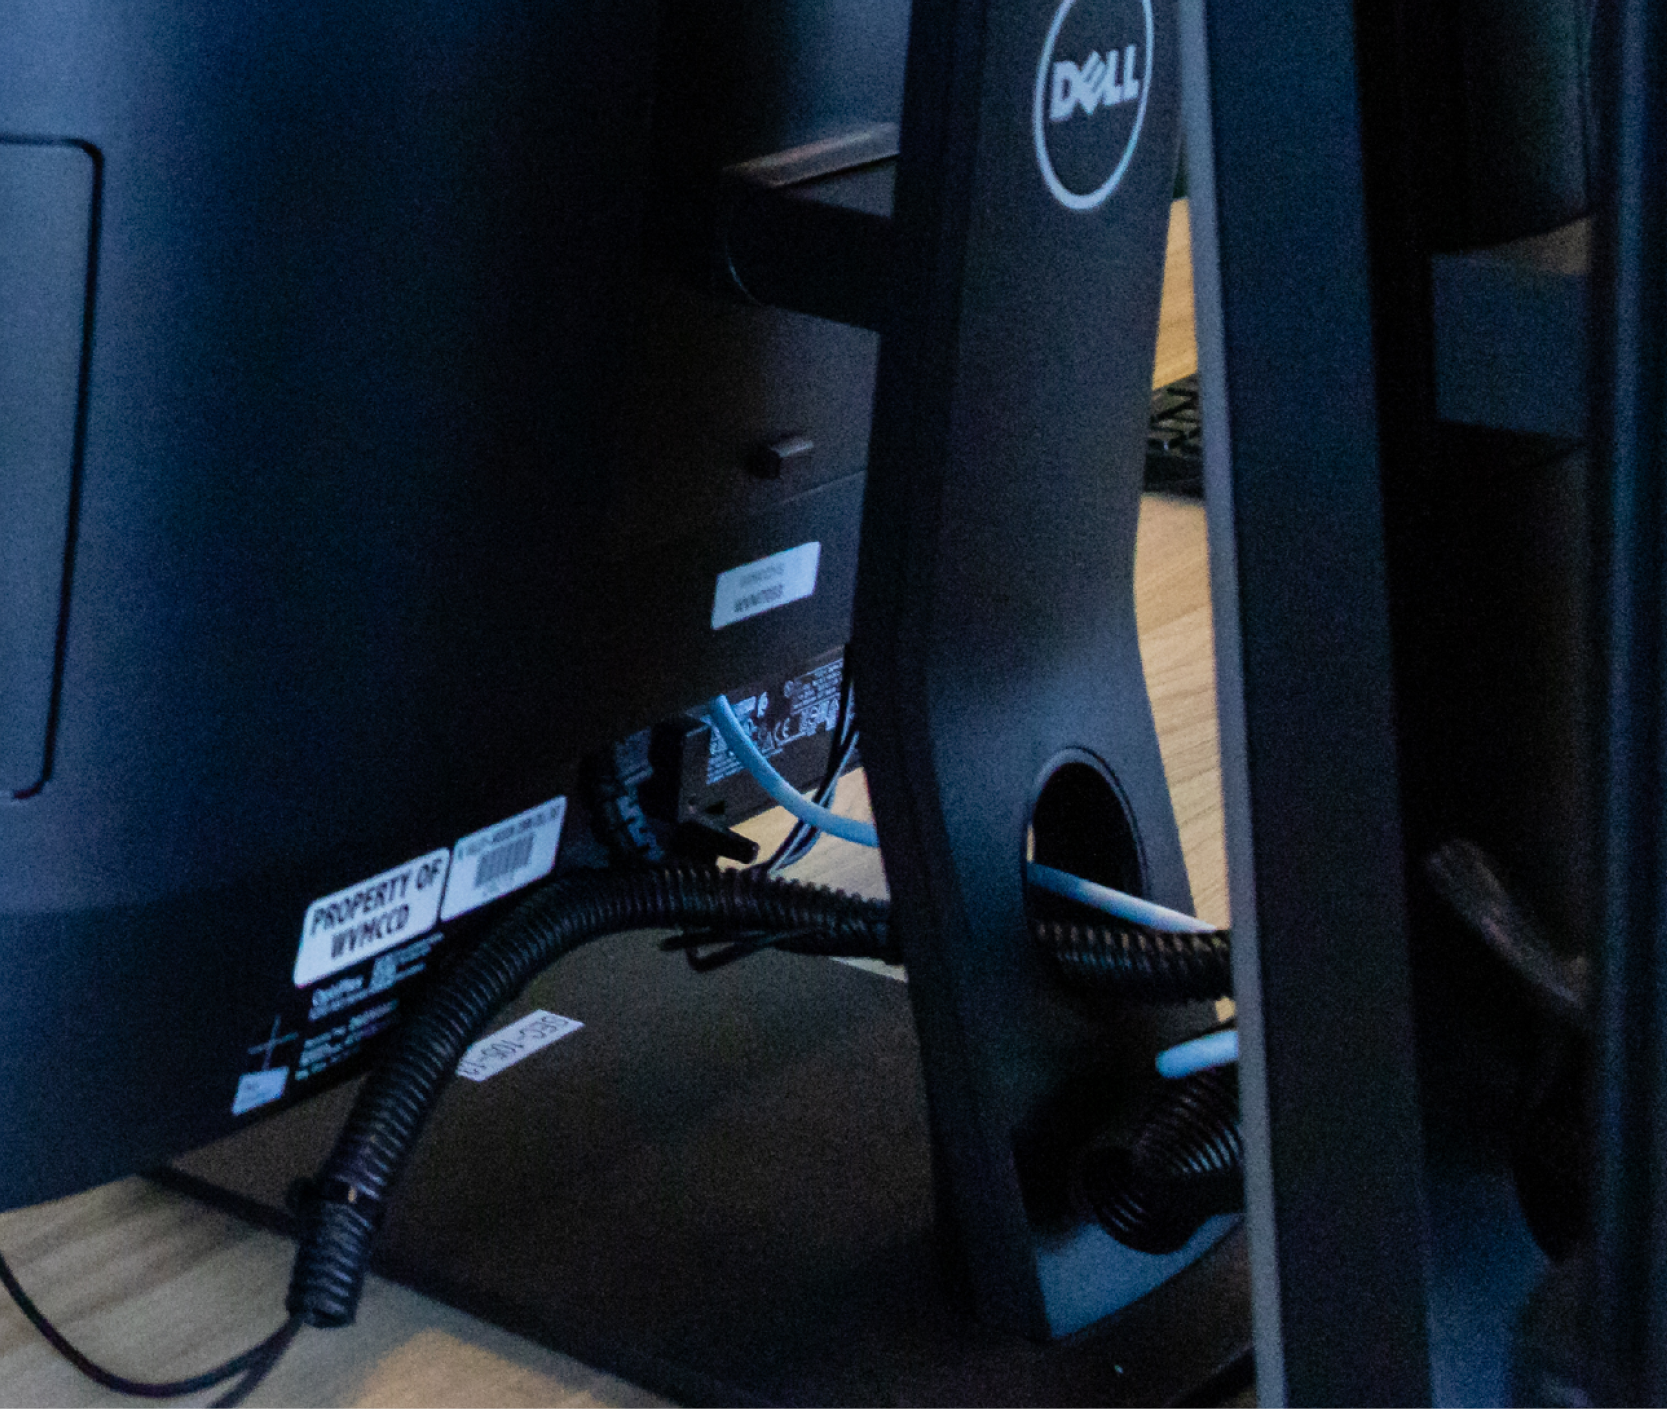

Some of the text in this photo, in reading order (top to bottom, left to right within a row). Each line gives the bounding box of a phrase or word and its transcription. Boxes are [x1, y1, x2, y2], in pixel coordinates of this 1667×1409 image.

[1049, 44, 1140, 123] DELL
[309, 869, 412, 937] PROPERTY
[415, 857, 443, 892] OF
[330, 904, 411, 960] WVMCCD
